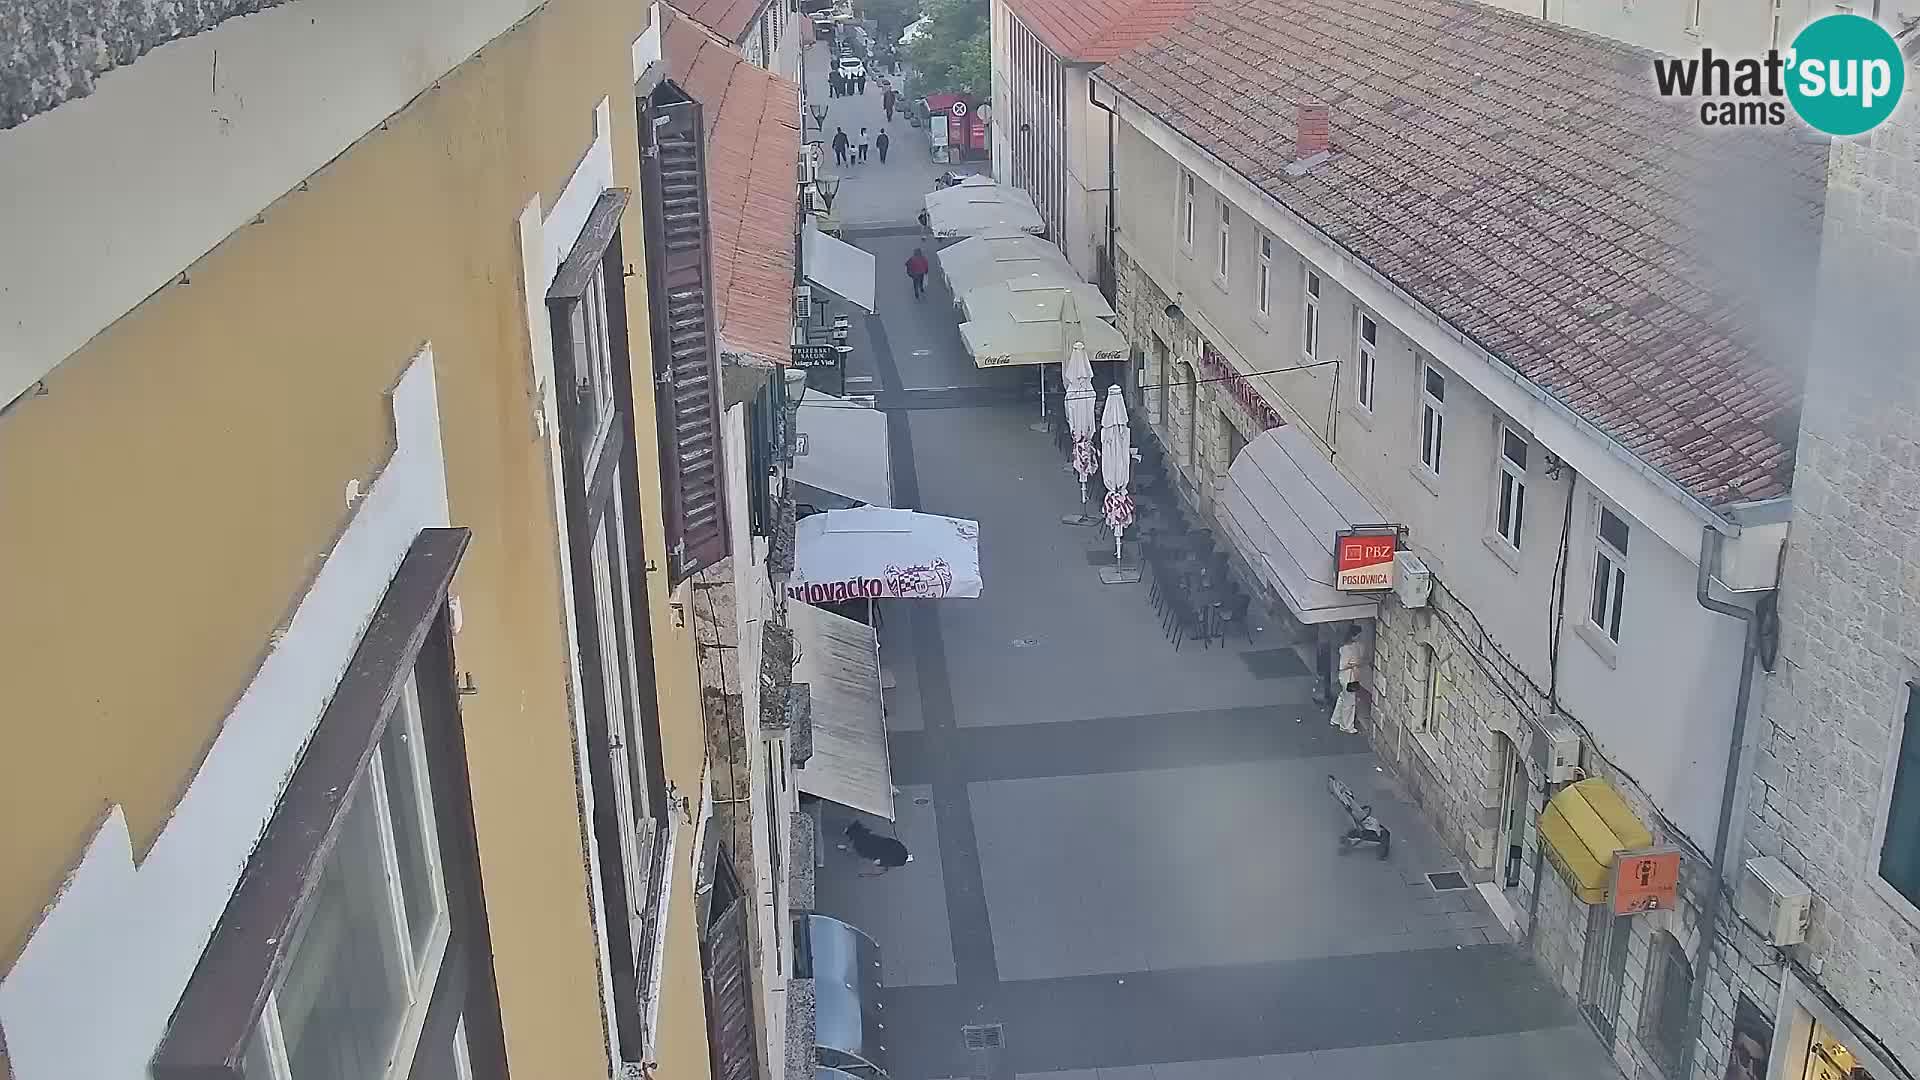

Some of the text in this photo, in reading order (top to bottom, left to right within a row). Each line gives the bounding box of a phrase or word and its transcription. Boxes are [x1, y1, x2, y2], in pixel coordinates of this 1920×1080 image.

[1365, 545, 1391, 558] PBZ
[1342, 574, 1388, 585] POSLOVNICA
[787, 576, 883, 604] arlovačko
